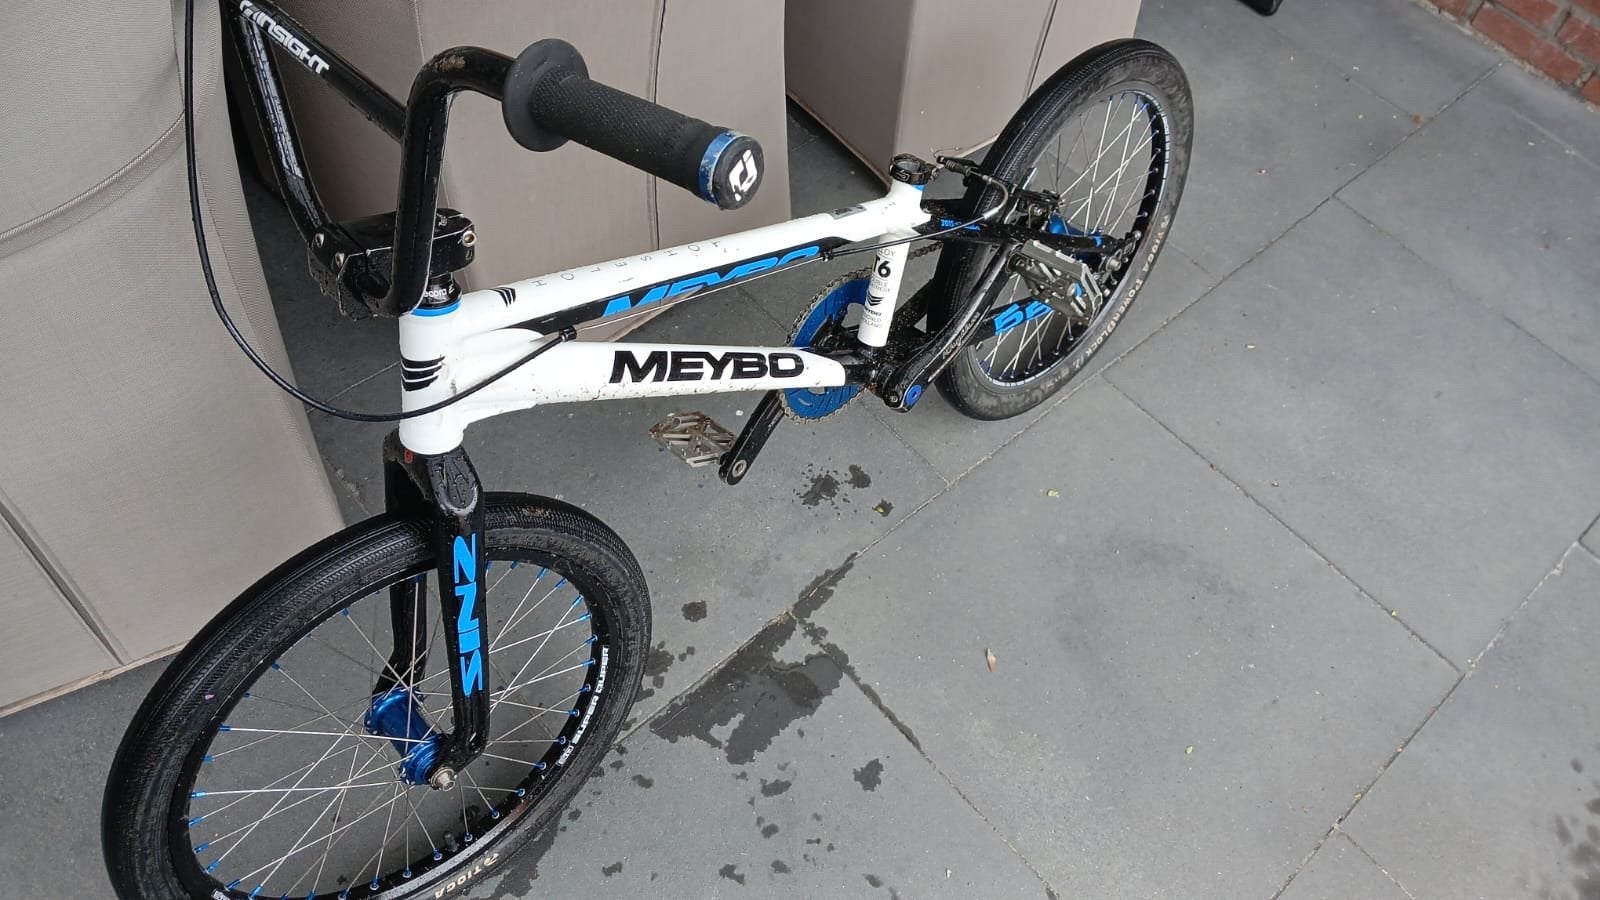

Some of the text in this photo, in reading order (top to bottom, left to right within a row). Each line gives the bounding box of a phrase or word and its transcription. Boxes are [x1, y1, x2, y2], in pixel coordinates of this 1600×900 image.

[252, 10, 330, 75] INSIGHT
[609, 350, 804, 384] MEYBO
[453, 533, 483, 696] SINZ
[571, 695, 600, 745] SUPER
[434, 868, 483, 900] TIOGA
